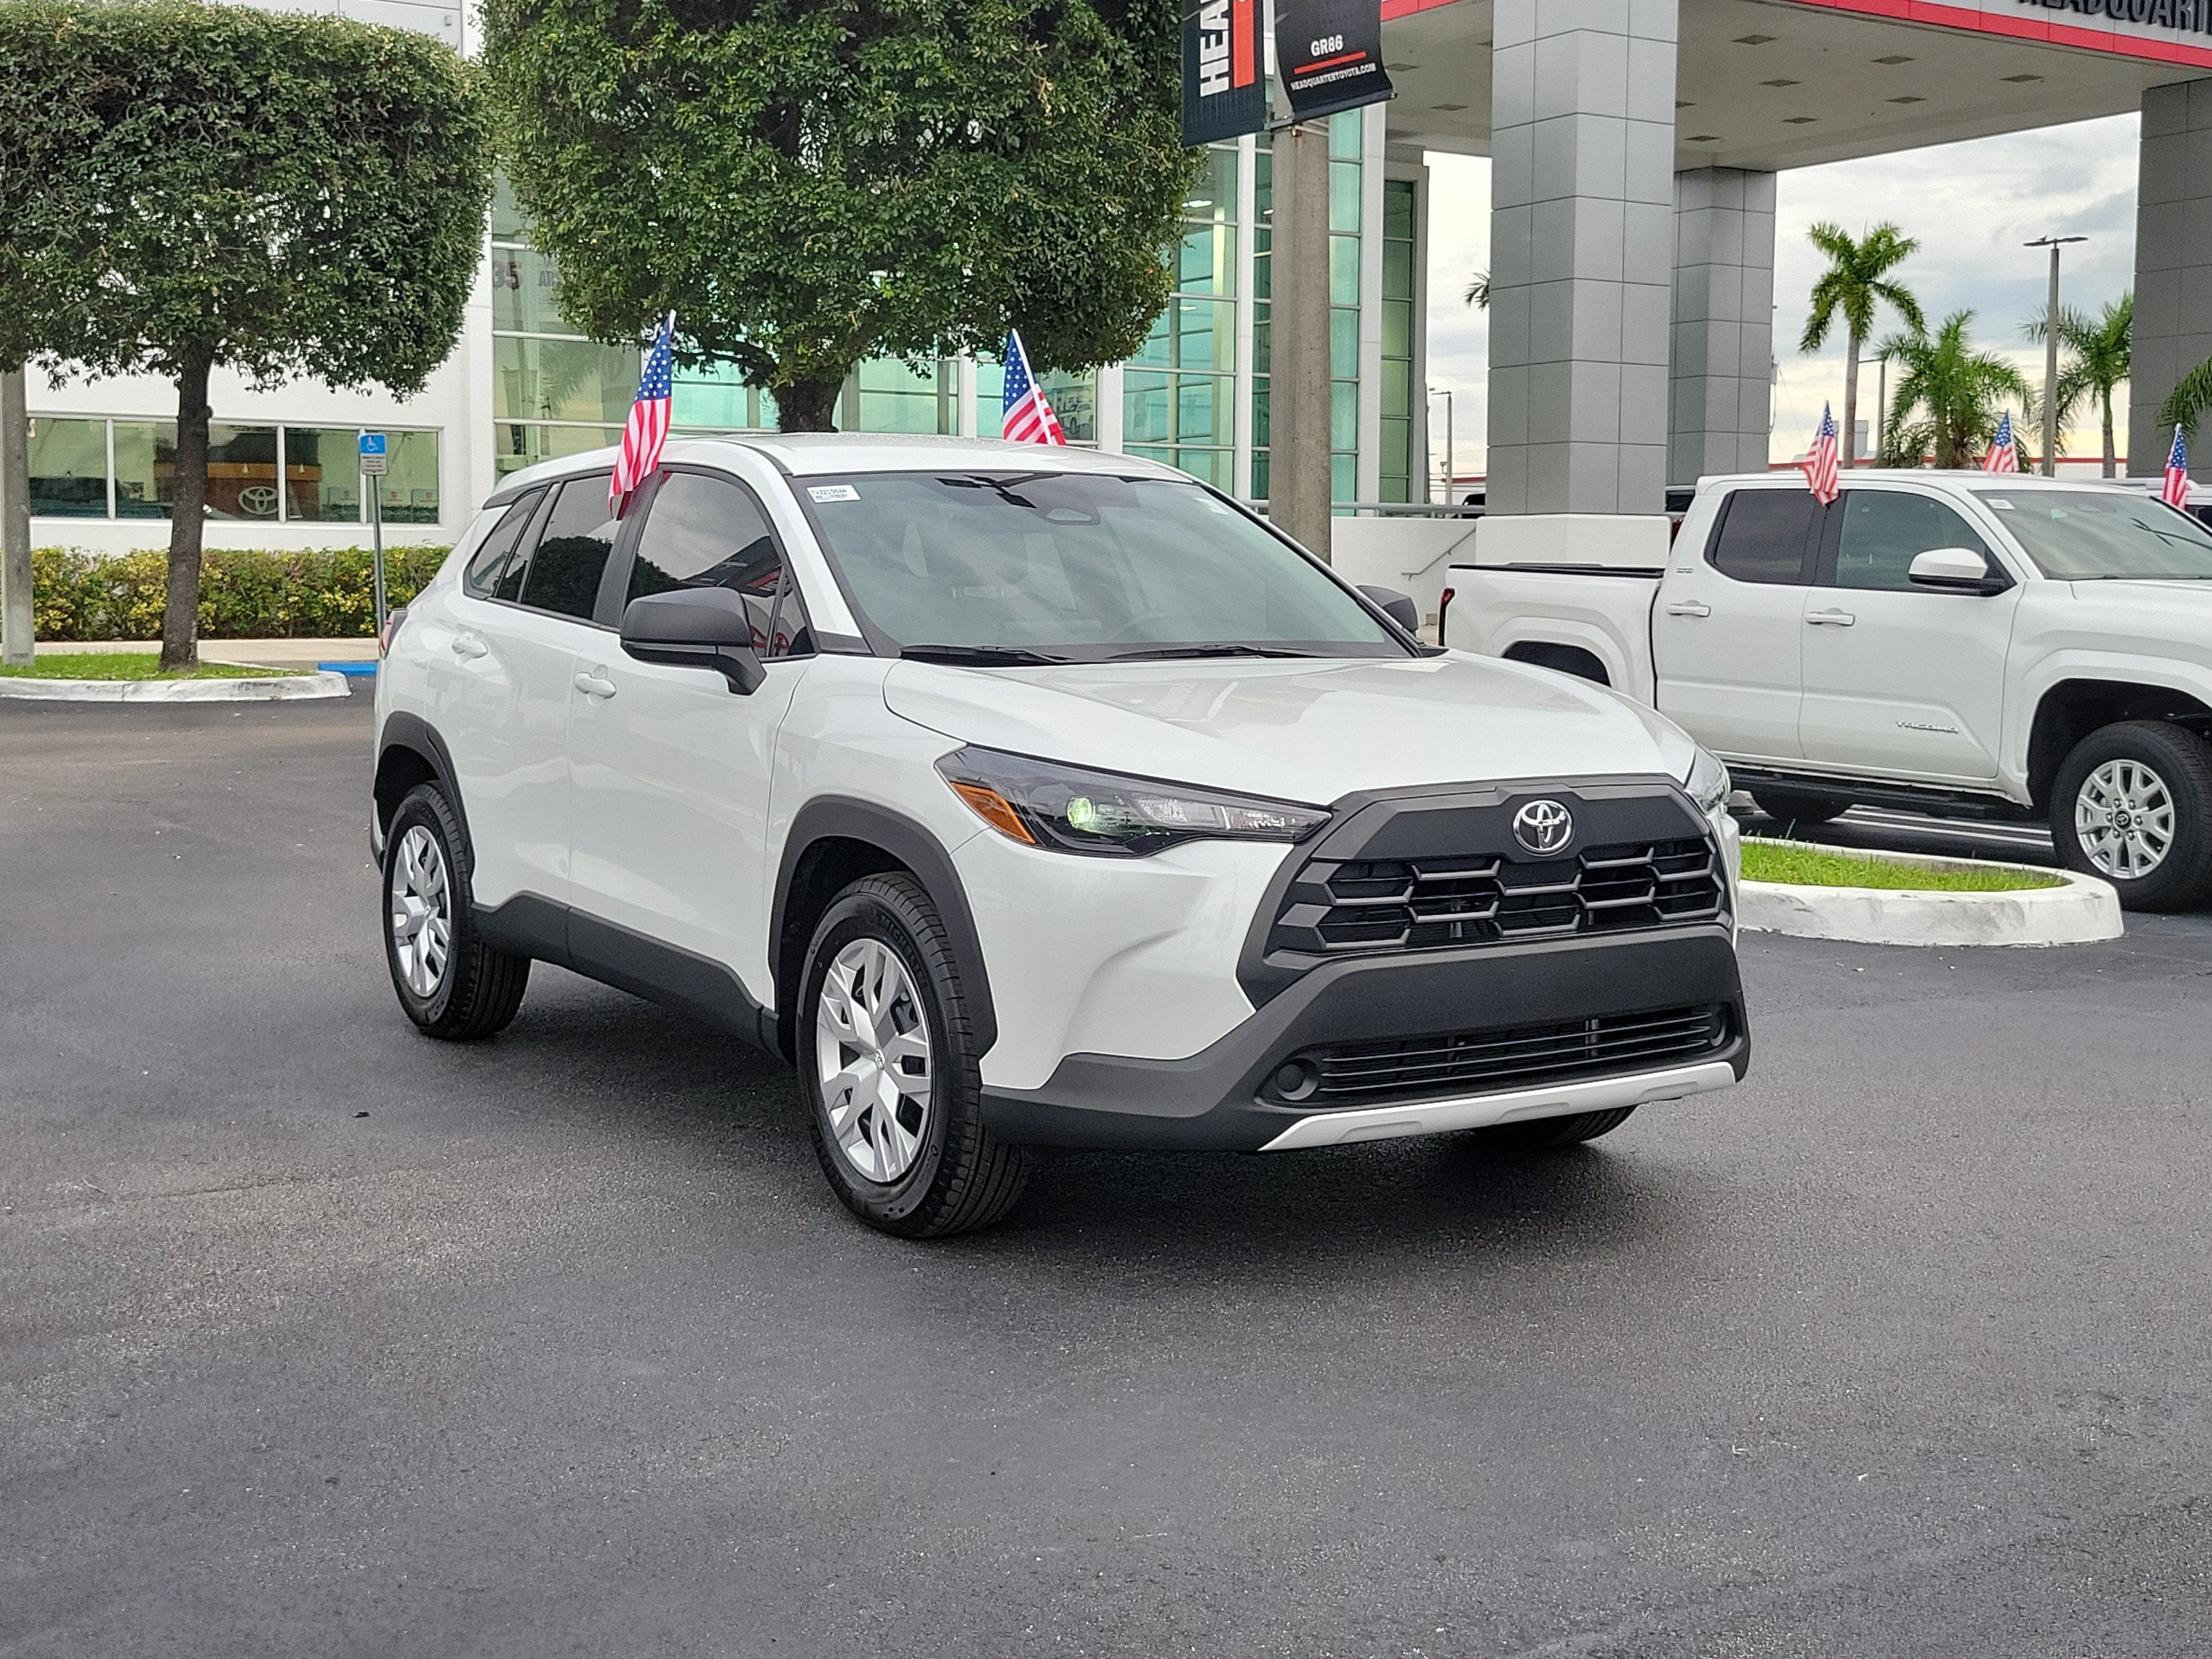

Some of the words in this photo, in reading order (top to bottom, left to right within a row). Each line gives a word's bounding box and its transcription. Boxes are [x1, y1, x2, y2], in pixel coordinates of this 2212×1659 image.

[1200, 0, 1229, 98] HEA
[1311, 35, 1343, 57] GR86
[1291, 63, 1376, 91] HEADQUARTERTOYOTA.COM
